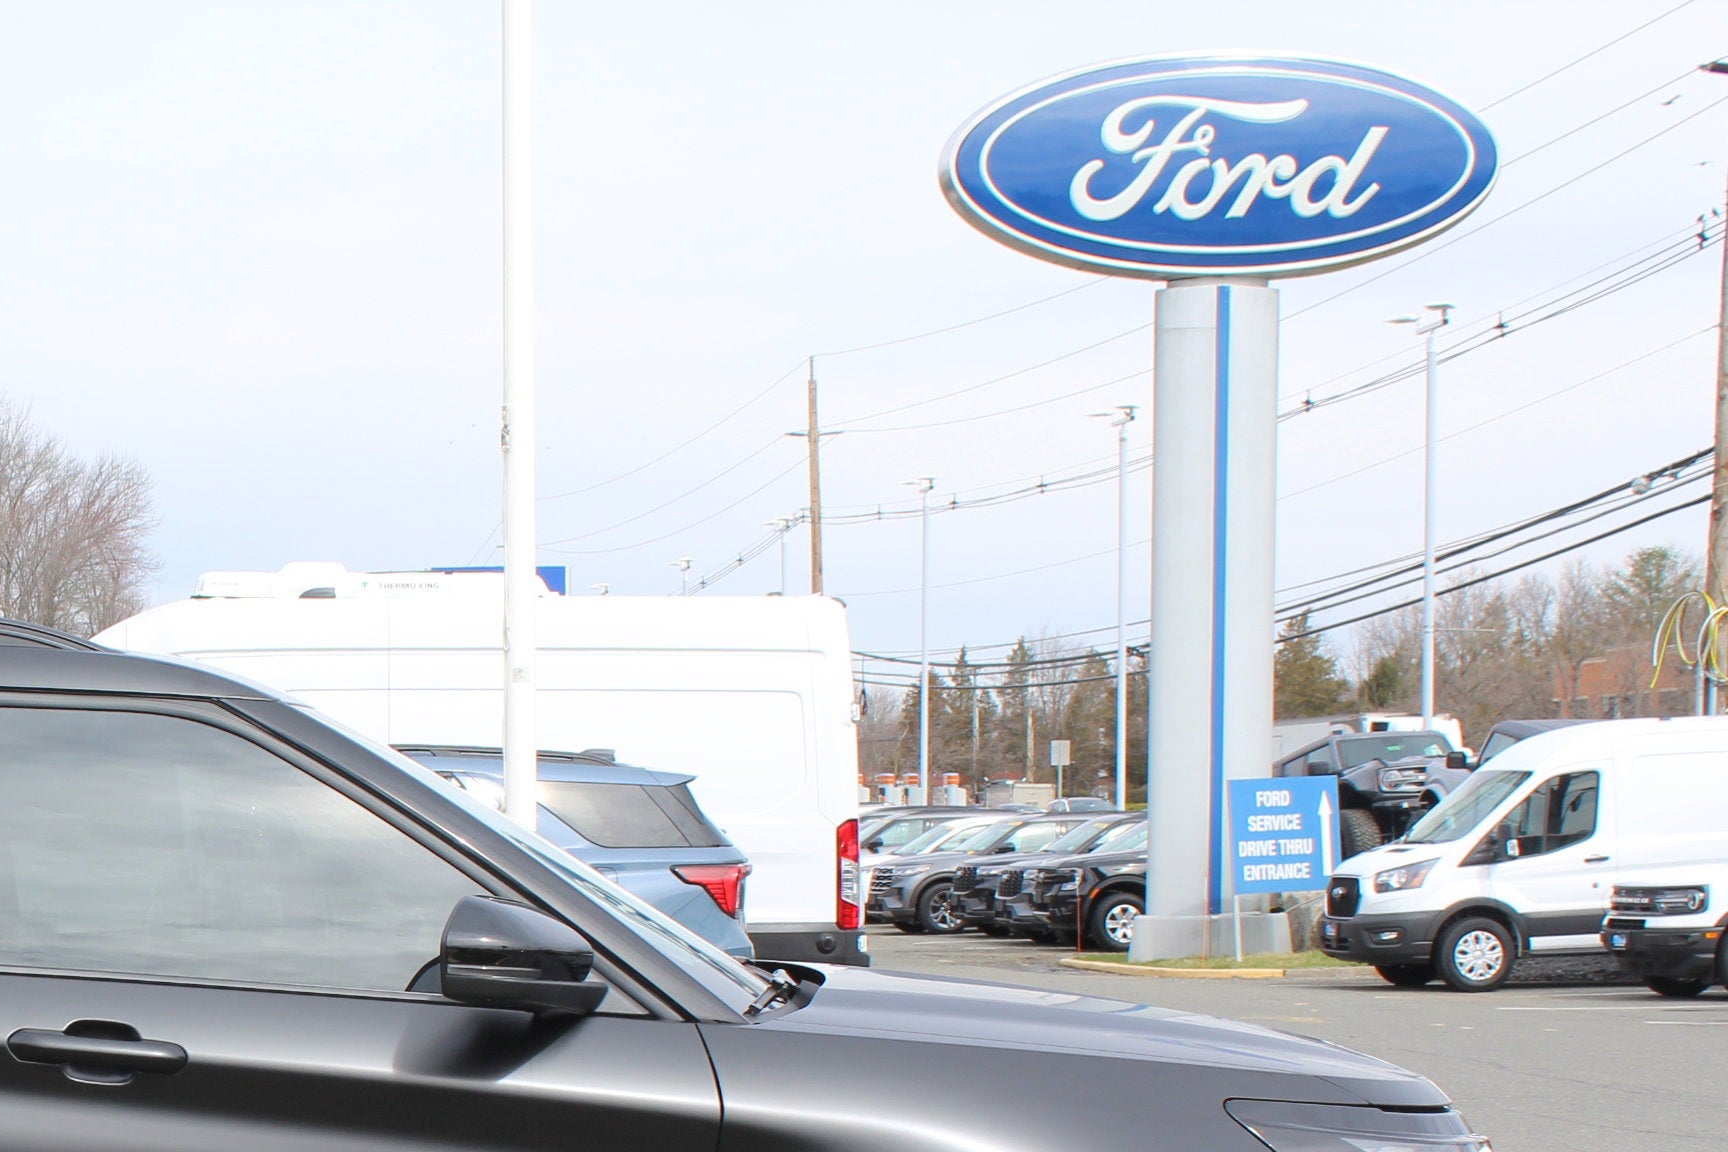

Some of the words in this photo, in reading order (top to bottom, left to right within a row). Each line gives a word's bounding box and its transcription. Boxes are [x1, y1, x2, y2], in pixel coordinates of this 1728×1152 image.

[1068, 94, 1390, 222] Ford
[378, 582, 416, 590] THERMO
[1255, 790, 1291, 808] FORD
[1247, 813, 1303, 833] SERVICE
[1238, 840, 1277, 858] DRIVE
[1278, 837, 1314, 856] THRU
[1243, 862, 1312, 881] ENTRANCE
